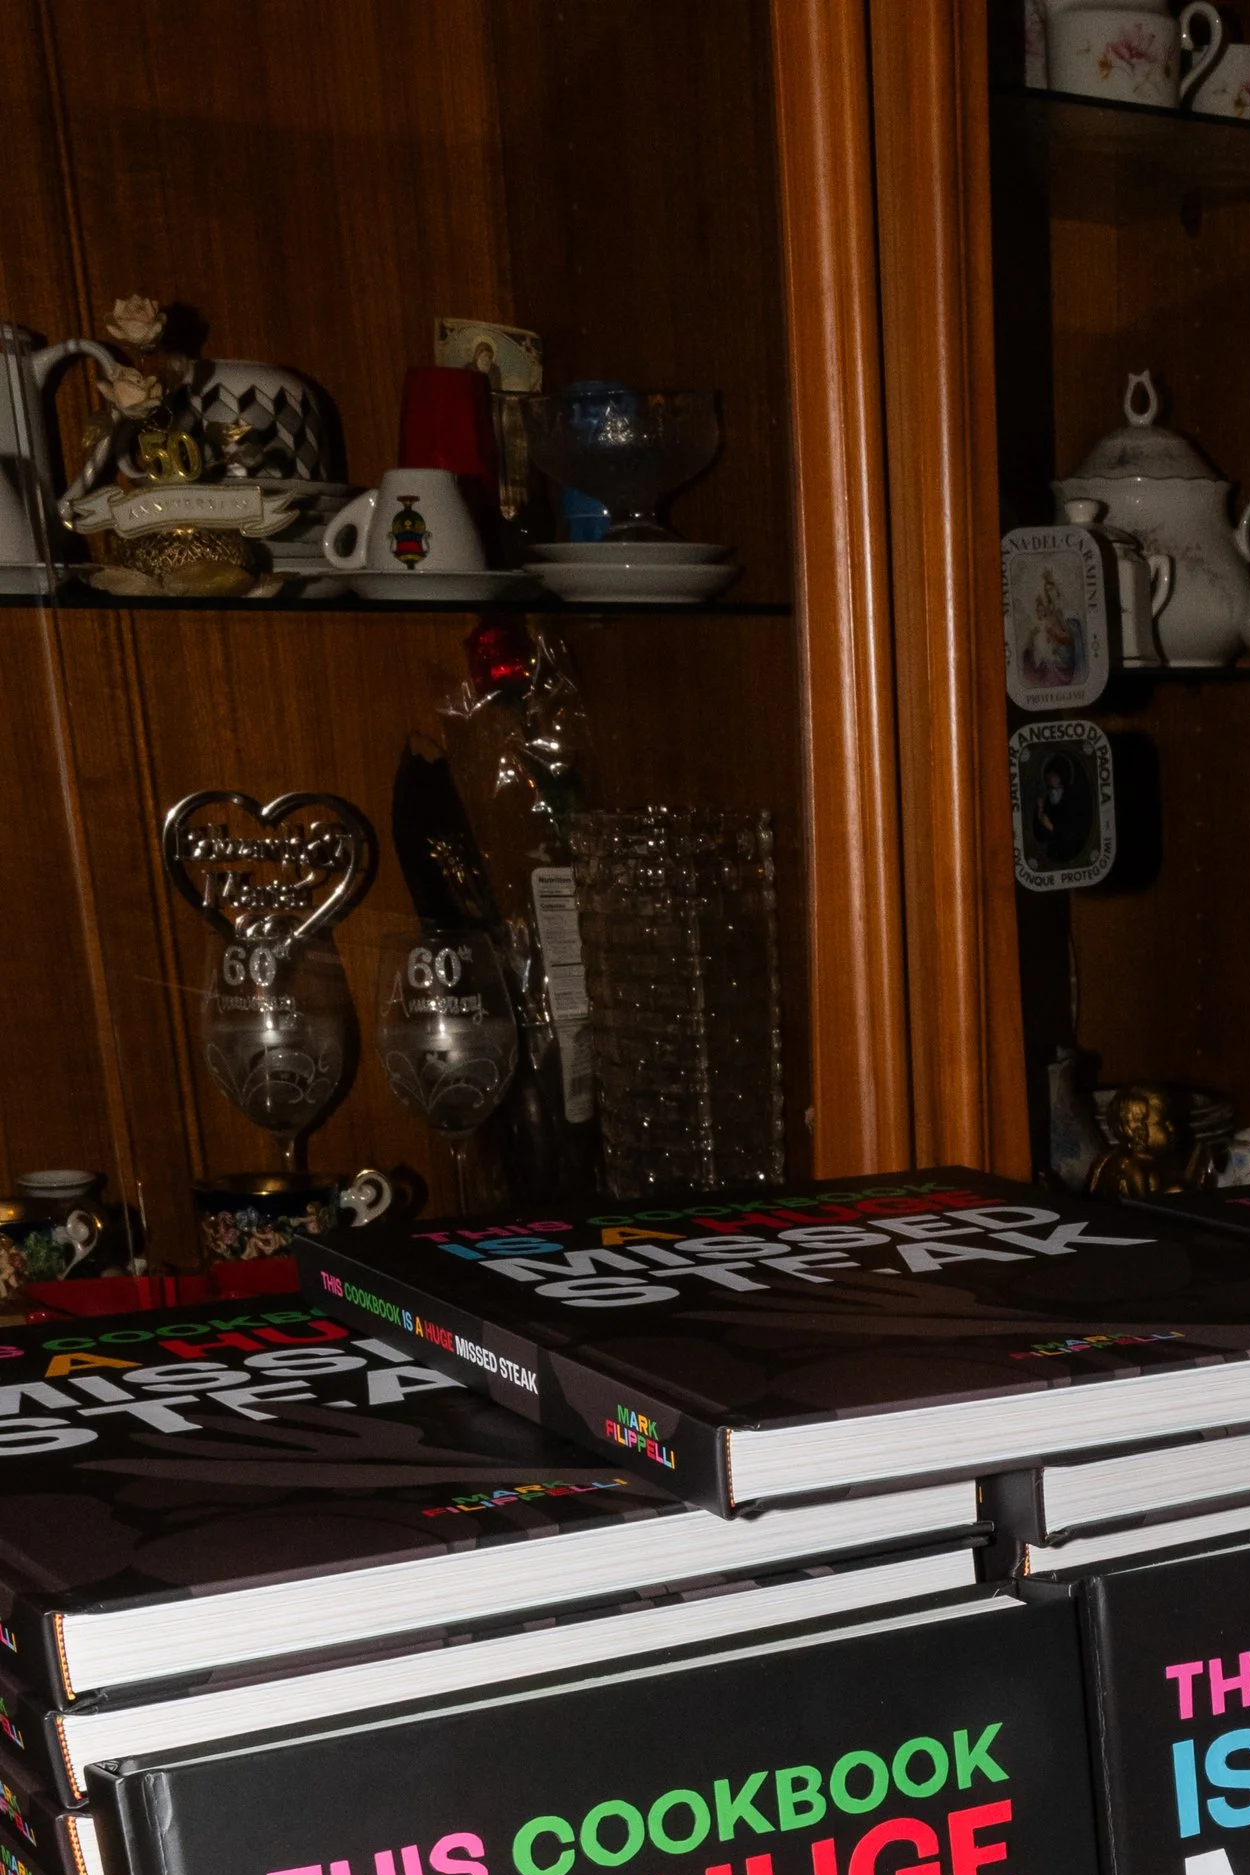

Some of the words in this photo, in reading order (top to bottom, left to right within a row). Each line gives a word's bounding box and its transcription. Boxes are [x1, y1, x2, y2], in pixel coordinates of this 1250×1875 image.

[138, 431, 202, 482] 50
[411, 1219, 575, 1244] THIS
[586, 1181, 960, 1226] COOKBOOK
[437, 1236, 564, 1261] IS
[601, 1226, 689, 1246] A
[691, 1189, 1003, 1234] HUGE
[478, 1206, 1061, 1282] MISSED
[534, 1221, 1158, 1308] STEAK
[320, 1270, 344, 1297] THIS
[344, 1283, 402, 1326] COOKBOOK
[401, 1309, 413, 1332] IS
[415, 1316, 424, 1338] A
[424, 1319, 455, 1353] HUGE
[454, 1335, 498, 1373] MISSED
[499, 1357, 539, 1395] STEAK
[44, 1352, 143, 1379] A
[604, 1418, 676, 1470] FILIPPELLI
[616, 1404, 659, 1441] MARK
